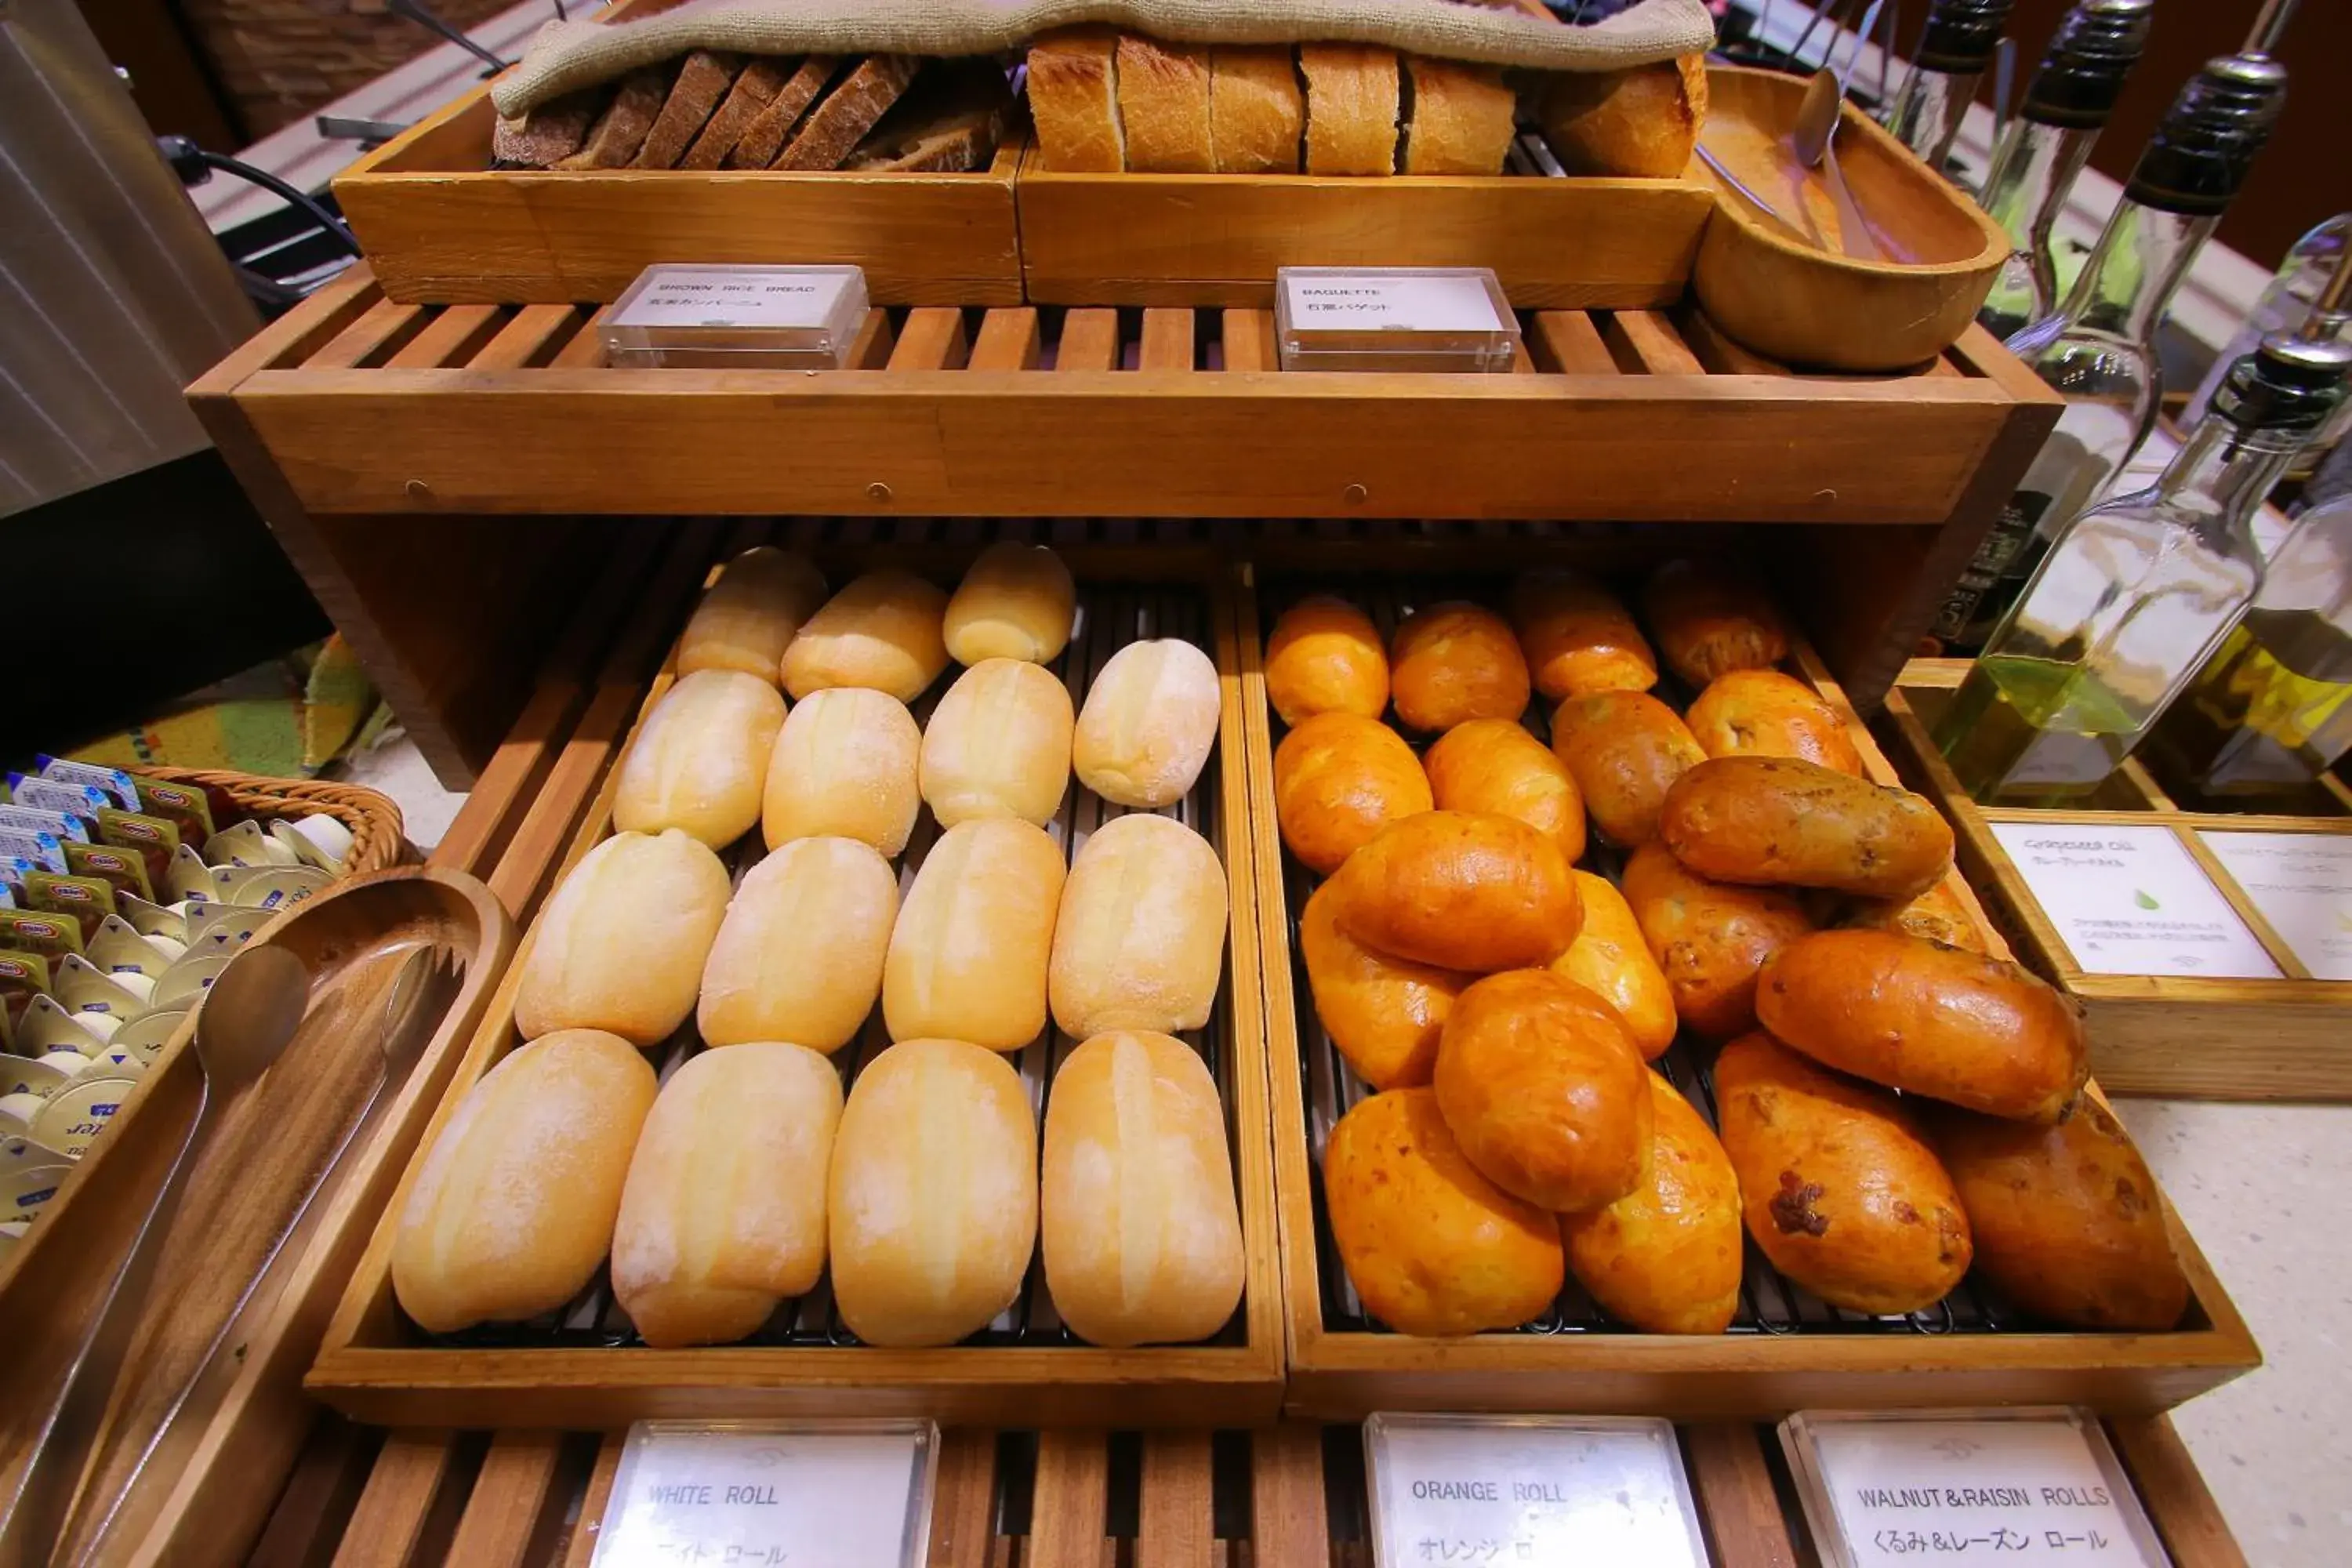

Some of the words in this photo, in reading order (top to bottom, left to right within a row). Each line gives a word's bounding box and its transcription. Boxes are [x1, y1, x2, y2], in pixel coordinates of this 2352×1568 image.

[649, 1485, 712, 1505] WHITE
[724, 1485, 779, 1505] ROLL
[1412, 1481, 1498, 1502] ORANGE
[1512, 1483, 1569, 1503] ROLL
[2040, 1486, 2110, 1507] ROLLS
[1418, 1537, 1499, 1562] オレンジ
[2045, 1530, 2107, 1551] ロール
[723, 1544, 787, 1566] ロール
